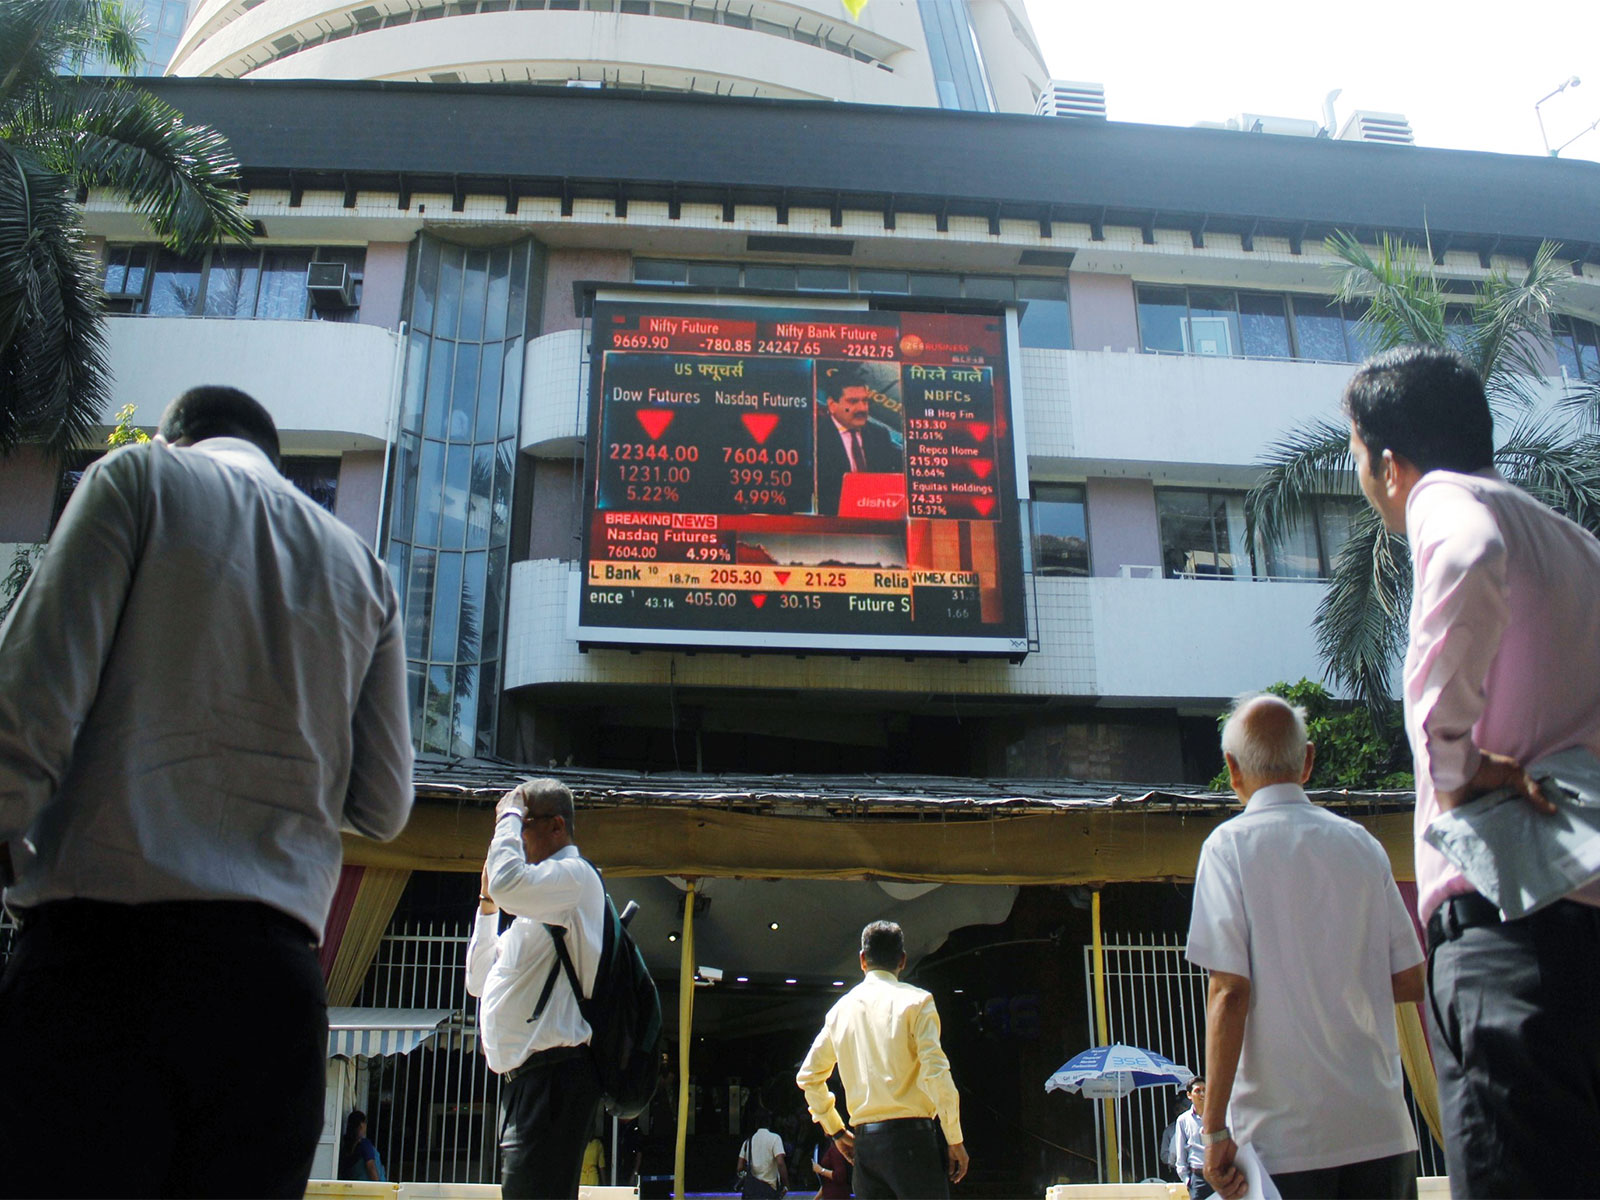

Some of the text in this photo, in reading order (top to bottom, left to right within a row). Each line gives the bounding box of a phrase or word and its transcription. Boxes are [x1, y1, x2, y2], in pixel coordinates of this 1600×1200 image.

[650, 319, 719, 335] Nifty Future
[776, 324, 878, 341] Nifty Bank Future
[613, 334, 752, 352] 9669.90 -780.85
[758, 340, 894, 358] 24247.65 -2242.75
[674, 363, 692, 376] US
[613, 387, 700, 404] Dow Futures
[715, 391, 808, 409] Nasdaq Futures
[924, 390, 971, 402] NBFCs
[938, 409, 956, 420] Hsg
[959, 410, 974, 419] Fin
[909, 420, 947, 430] 153.30
[908, 431, 943, 441] 21.61%
[610, 443, 699, 462] 22344.00
[722, 447, 799, 466] 7604.00
[919, 445, 979, 456] Repco Home
[909, 456, 949, 467] 215.90
[619, 465, 690, 483] 1231.00
[730, 469, 792, 487] 399.50
[910, 467, 945, 478] 16.64%
[627, 486, 679, 502] 5.22%
[912, 482, 993, 495] Equitas Holdings
[734, 490, 786, 506] 4.99%
[911, 494, 943, 504] 74.35
[911, 505, 947, 515] 15.37%
[605, 514, 716, 528] BREAKING NEWS
[607, 529, 717, 544] Nasdaq Futures
[608, 546, 730, 561] 7604.00 4.99%
[605, 565, 641, 580] Bank
[669, 574, 700, 584] 18.7m
[710, 570, 762, 584] 205.30
[805, 572, 847, 587] 21.25
[874, 573, 909, 588] Relia
[590, 591, 623, 604] ence
[645, 598, 675, 608] 43.1k
[685, 592, 737, 607] 405.00
[780, 595, 821, 609] 30.15
[849, 596, 895, 612] Future
[901, 598, 910, 611] S
